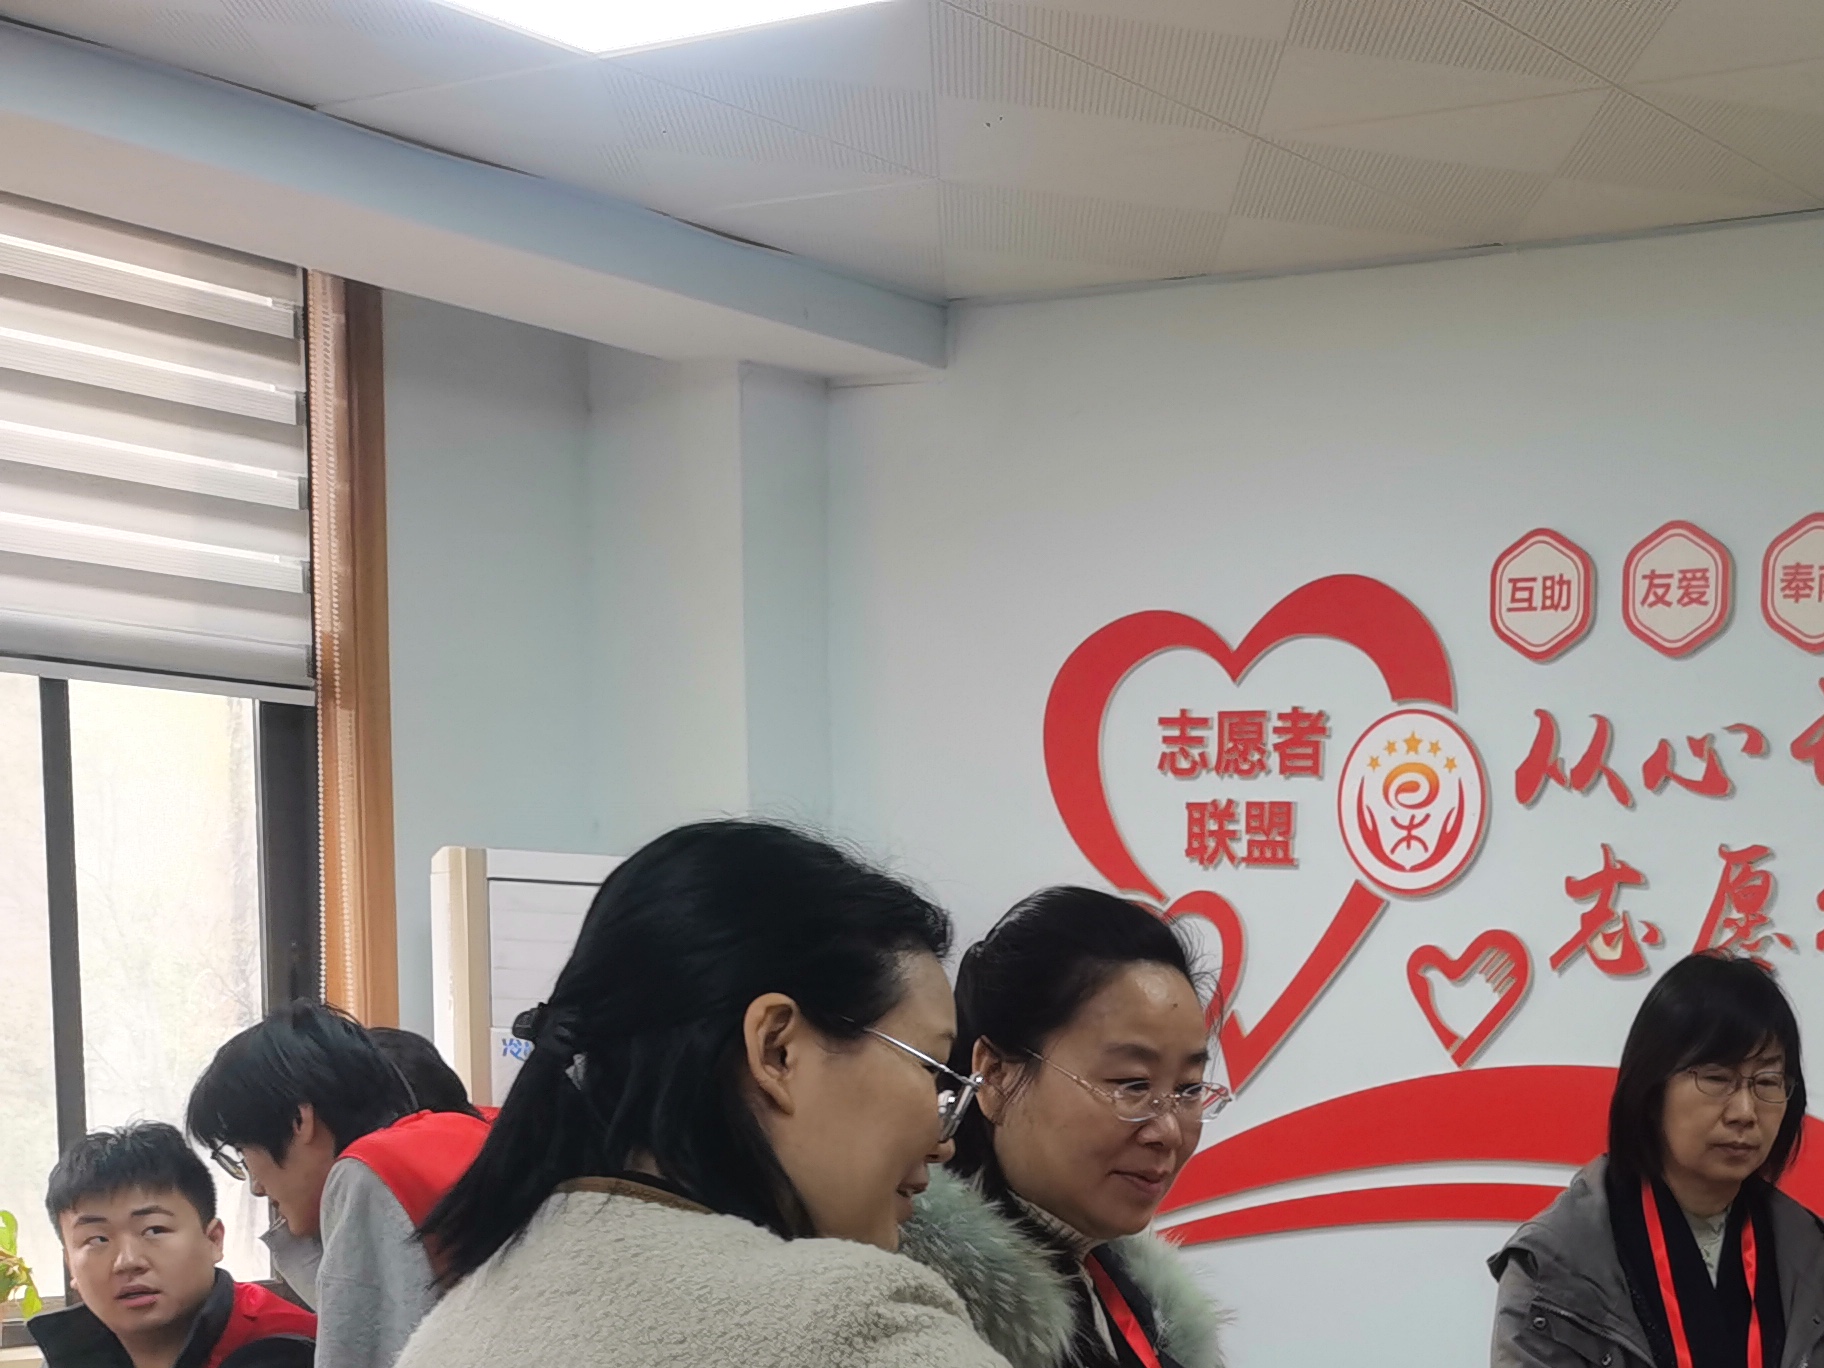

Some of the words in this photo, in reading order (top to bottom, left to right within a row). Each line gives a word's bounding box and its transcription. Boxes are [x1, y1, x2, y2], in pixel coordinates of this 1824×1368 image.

[1505, 576, 1572, 614] 互助
[1640, 566, 1711, 607] 友爱
[1157, 706, 1330, 779] 志愿者
[1185, 799, 1297, 868] 联盟
[502, 1038, 532, 1062] 冷
